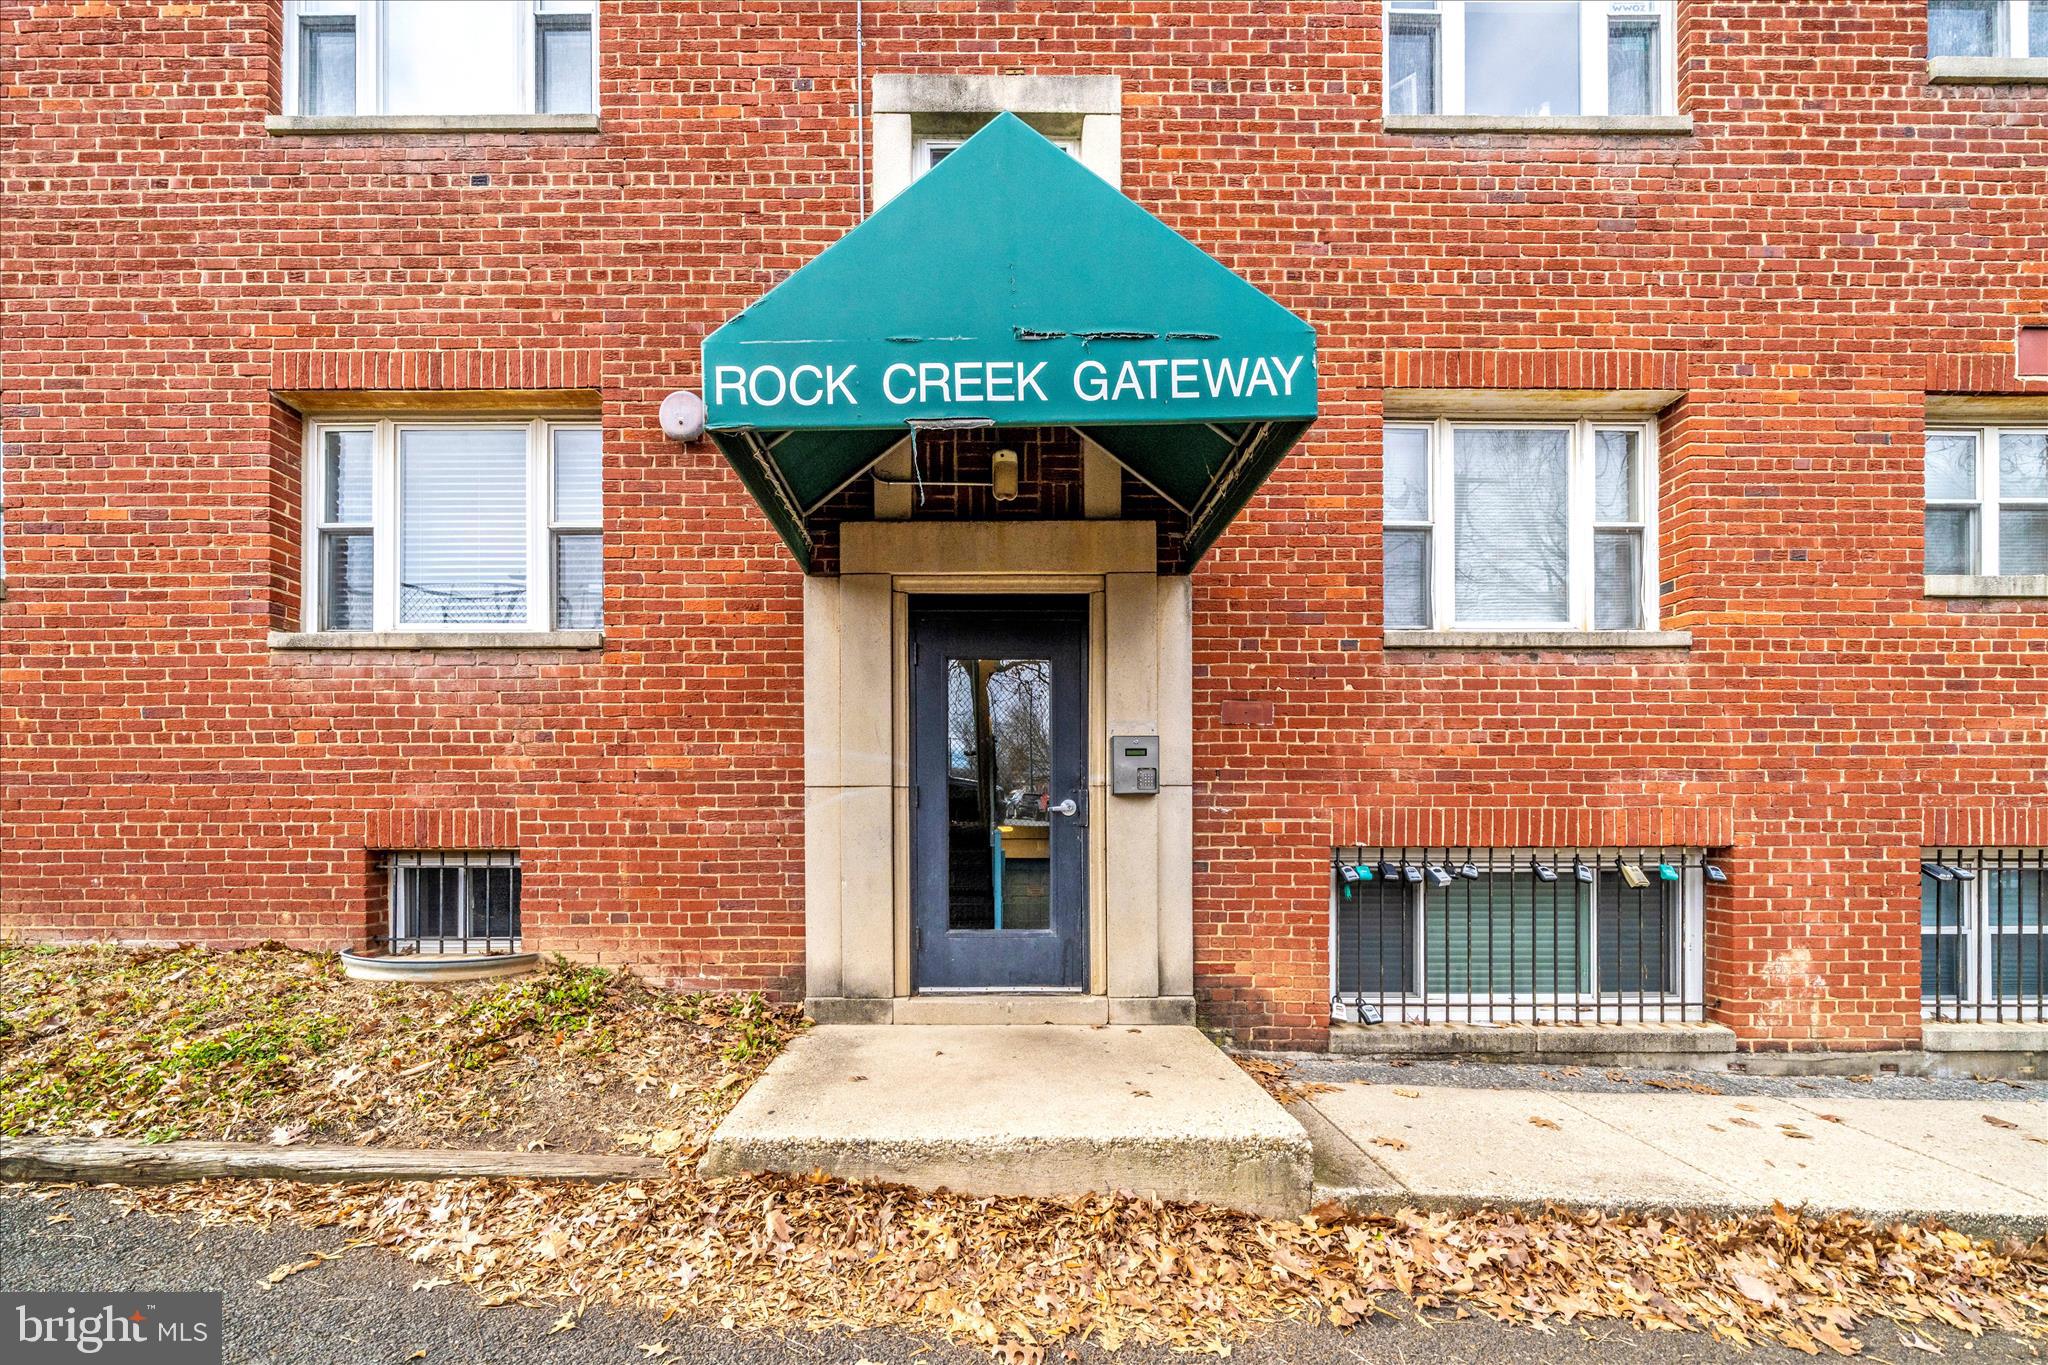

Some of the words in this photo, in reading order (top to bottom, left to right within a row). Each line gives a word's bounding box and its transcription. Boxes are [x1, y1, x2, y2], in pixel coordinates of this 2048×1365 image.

[715, 365, 857, 406] ROCK
[882, 361, 1048, 404] CREEK
[1073, 355, 1304, 402] GATEWAY
